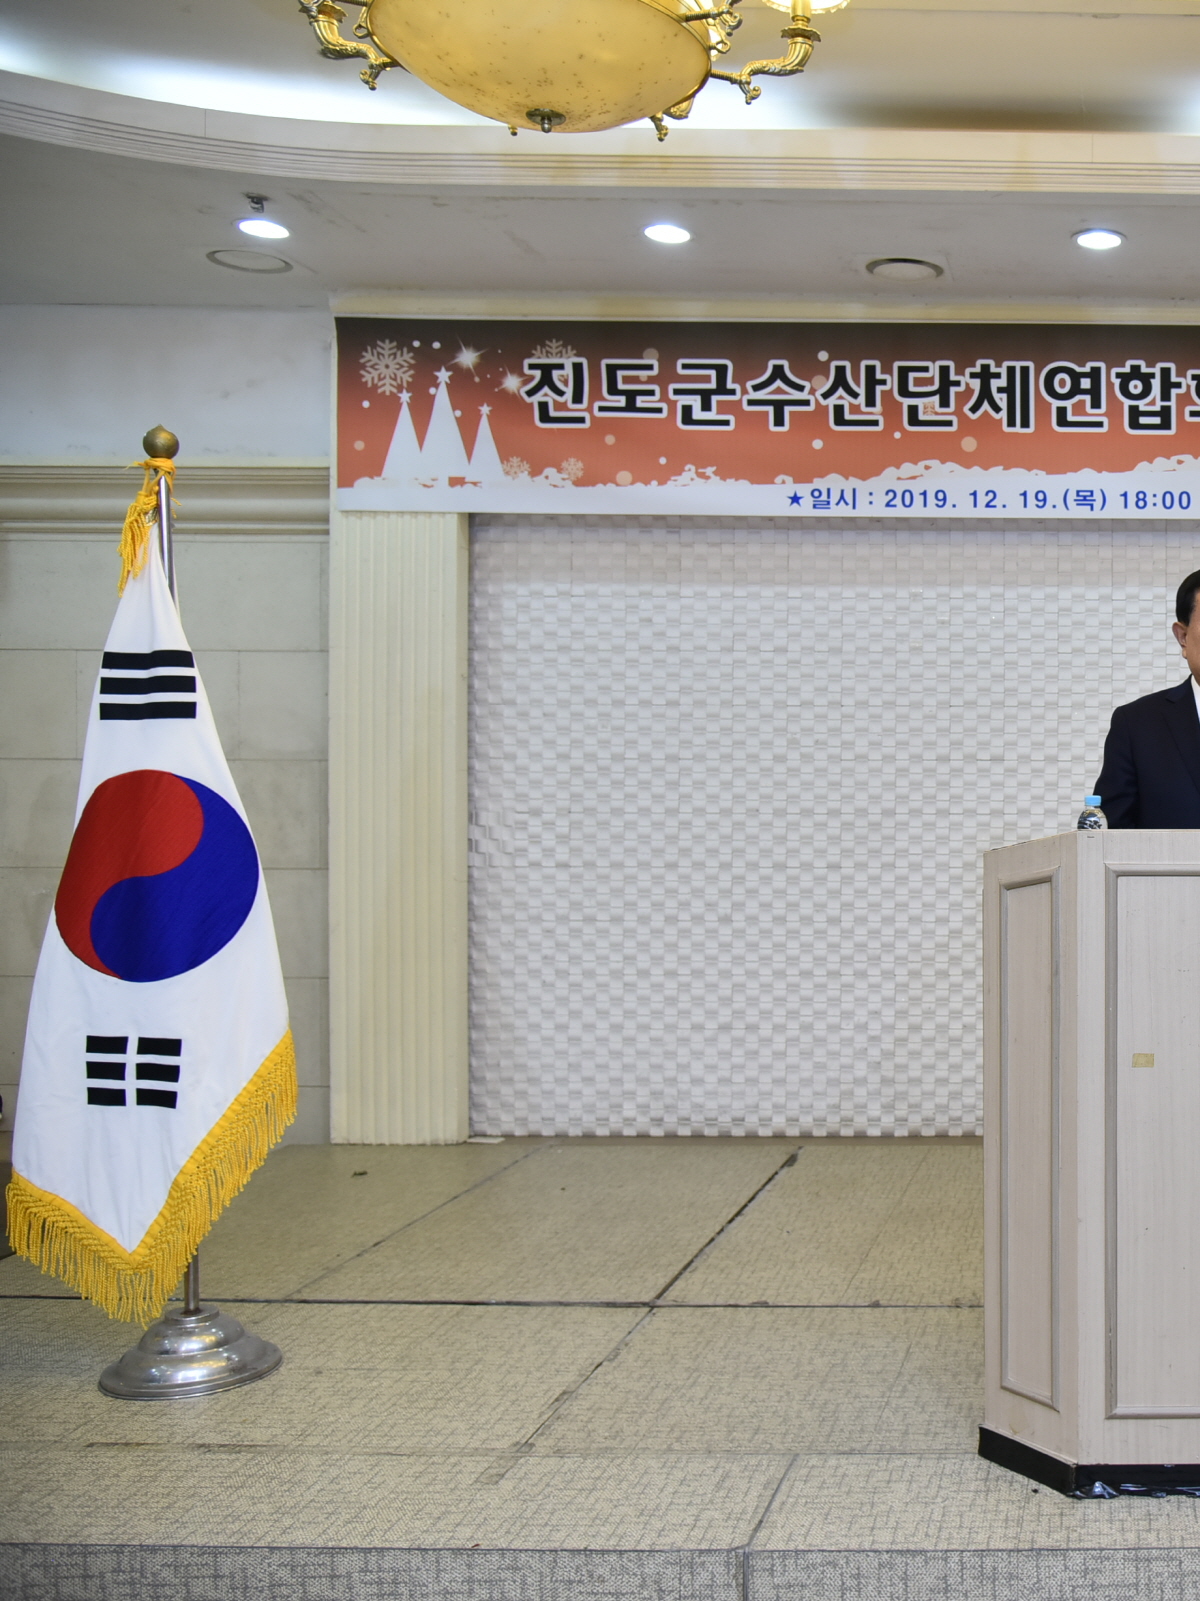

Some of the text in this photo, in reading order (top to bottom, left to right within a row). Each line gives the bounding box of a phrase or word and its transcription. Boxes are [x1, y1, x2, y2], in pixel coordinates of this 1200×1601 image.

[810, 487, 858, 511] 일시
[884, 488, 958, 509] 2019.
[969, 489, 1008, 510] 12.
[1019, 488, 1108, 512] 19.(목)
[1119, 490, 1193, 511] 18:00
